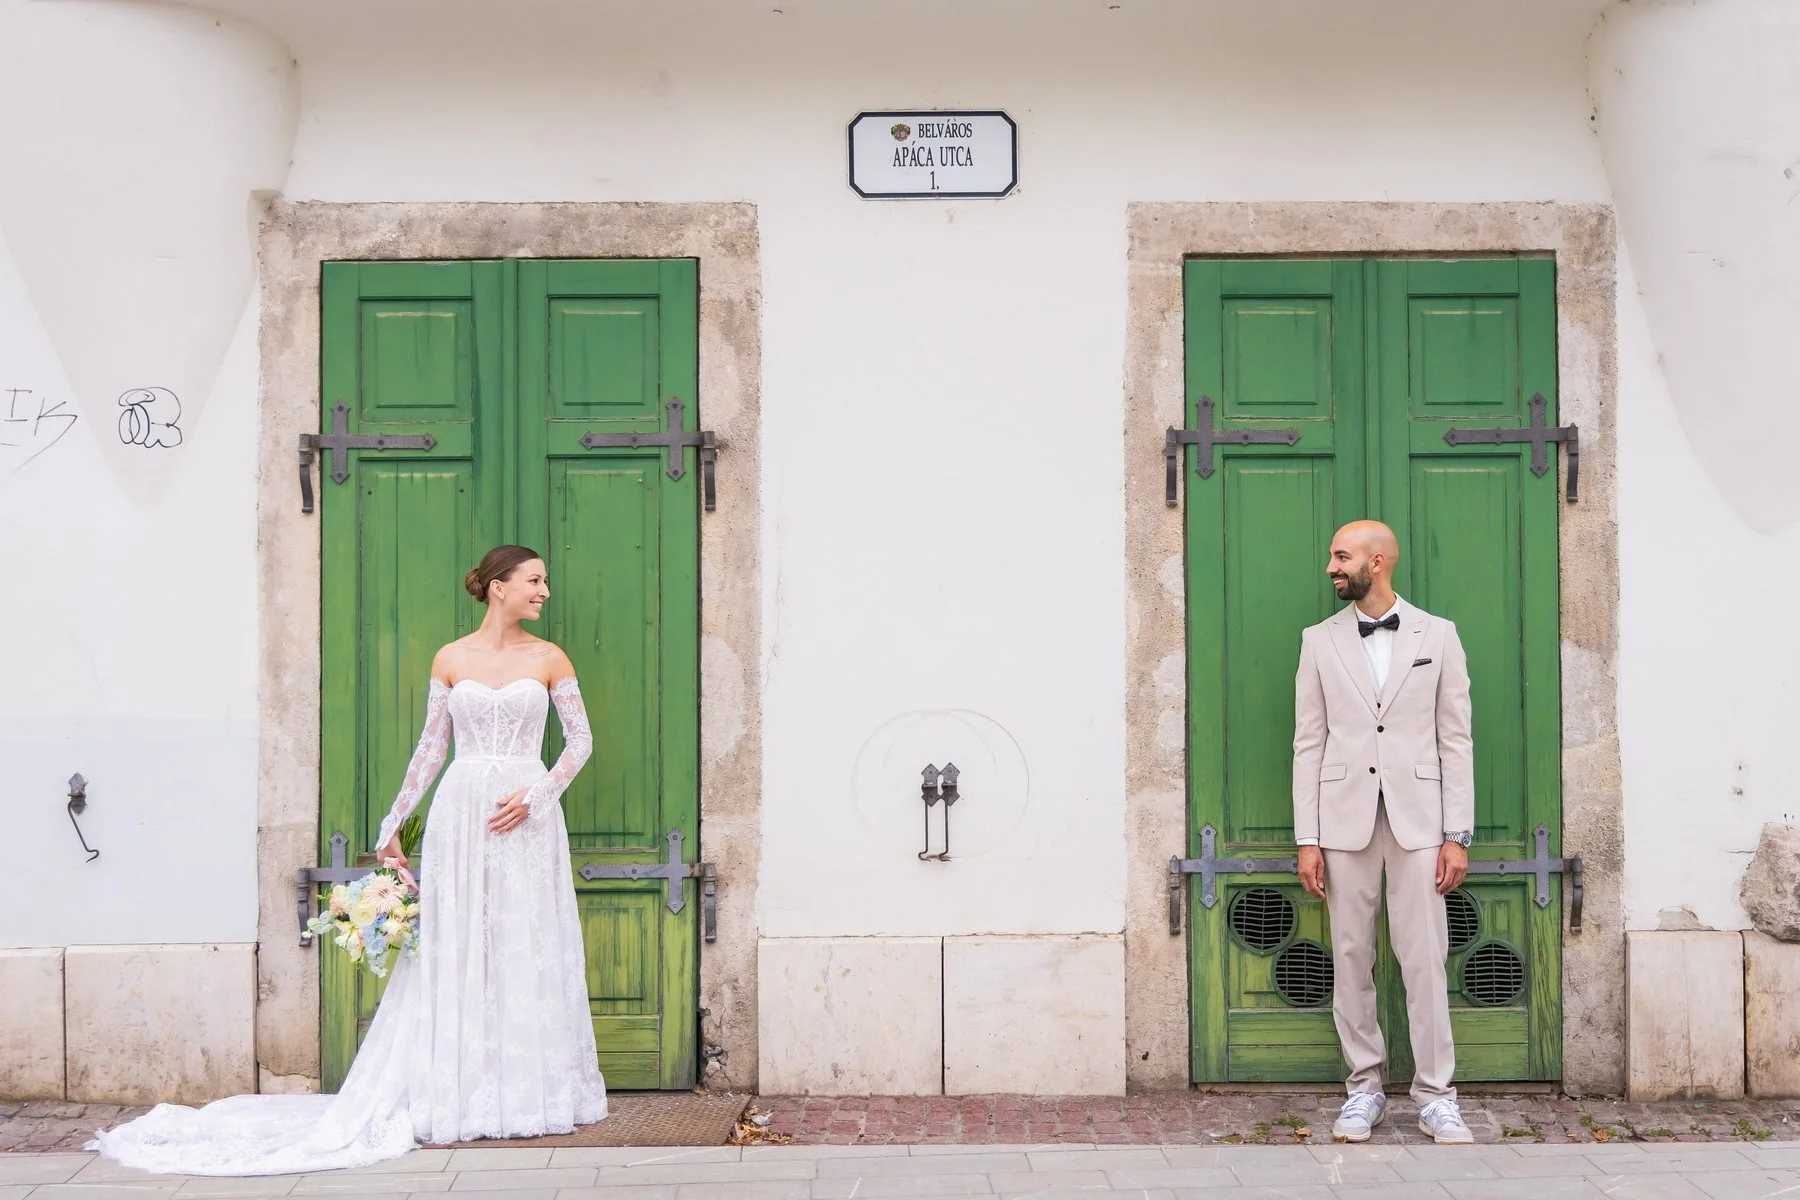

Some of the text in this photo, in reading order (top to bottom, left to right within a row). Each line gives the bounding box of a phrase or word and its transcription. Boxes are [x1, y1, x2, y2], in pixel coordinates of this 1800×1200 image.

[918, 119, 973, 138] BELVÁROS
[893, 141, 974, 167] APÁCA UTCA
[929, 170, 940, 190] 1.
